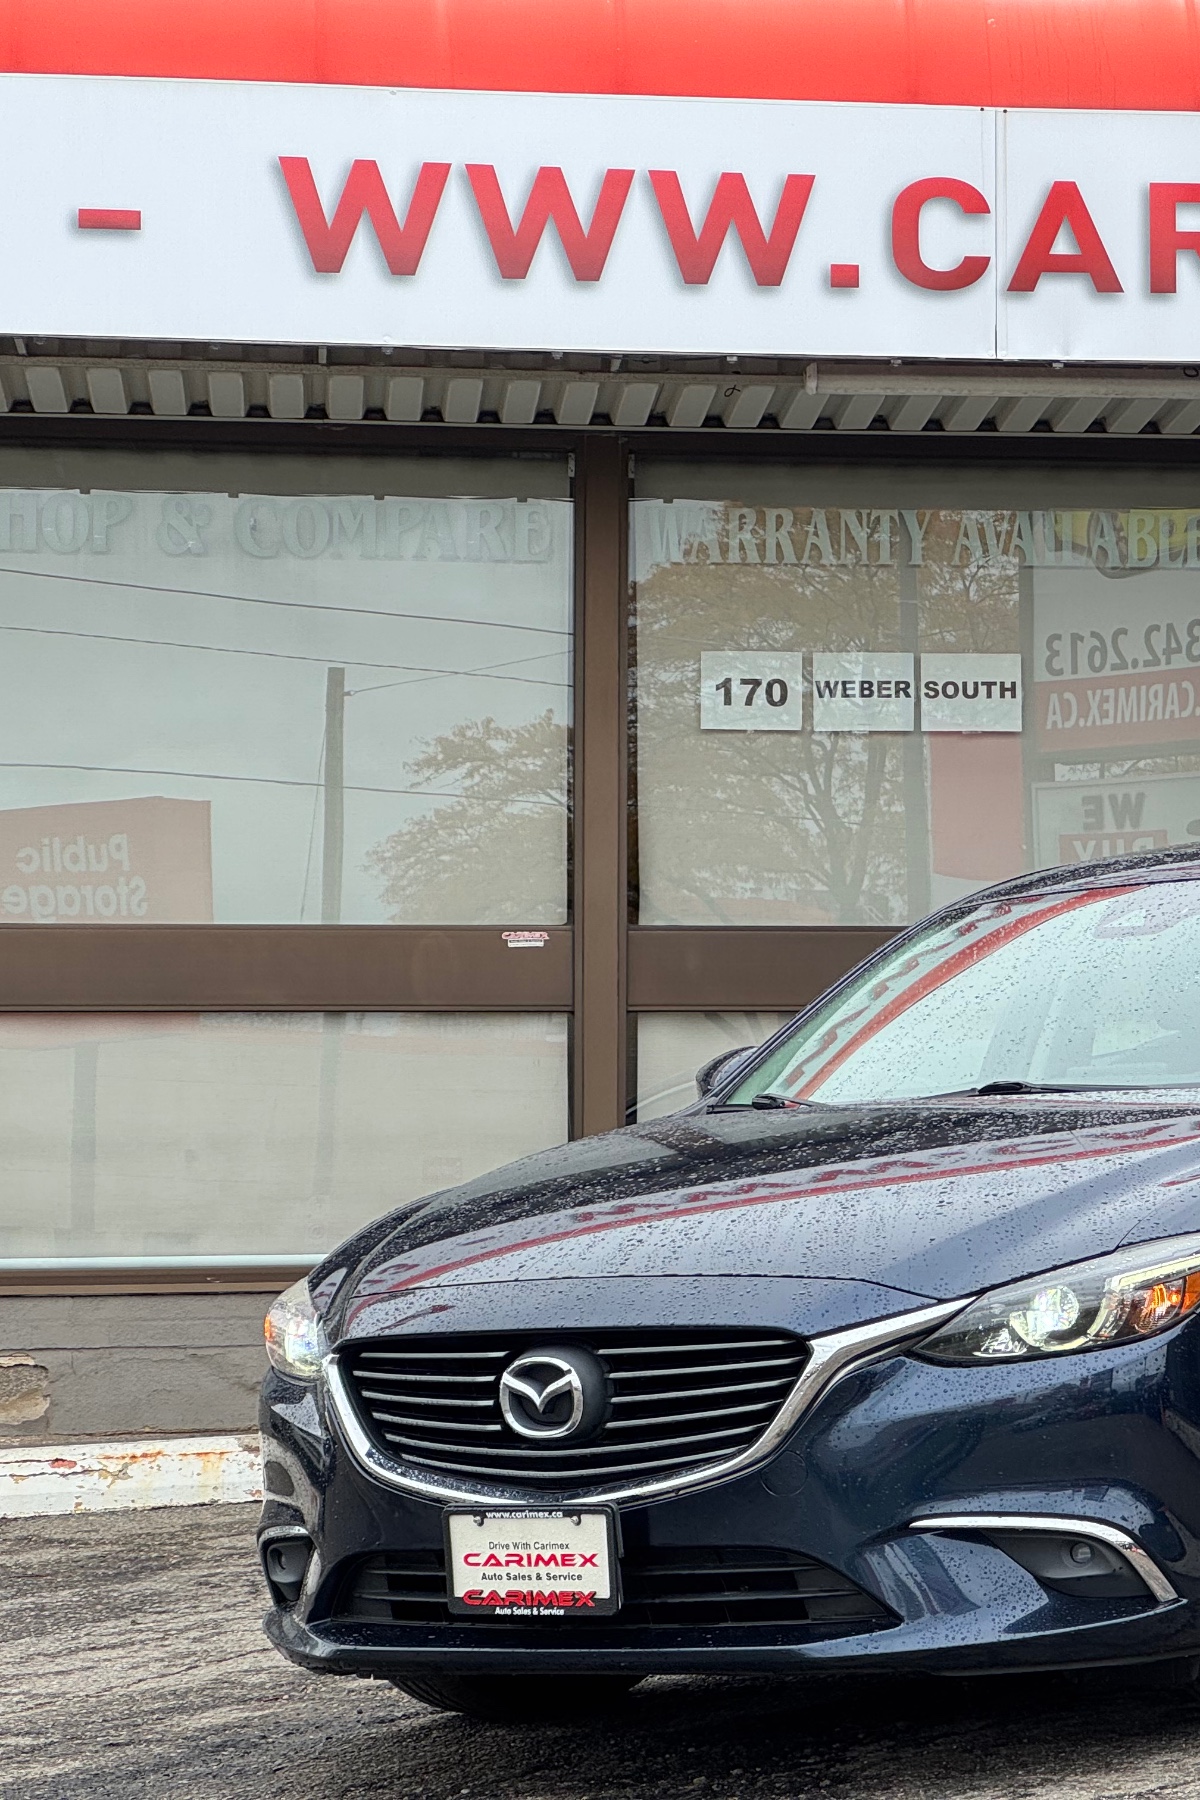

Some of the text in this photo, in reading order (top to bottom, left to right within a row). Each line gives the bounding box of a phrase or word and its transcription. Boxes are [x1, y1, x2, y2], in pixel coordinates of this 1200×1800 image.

[156, 494, 213, 556] &
[233, 498, 553, 564] COMPARE
[649, 506, 934, 567] WARRANTY
[714, 677, 1018, 708] 170 WEBER SOUTH
[485, 1510, 564, 1519] www.carimex.ca
[488, 1541, 570, 1550] Drive With Carimex
[463, 1552, 599, 1568] CARIMEX
[481, 1572, 583, 1581] Auto Sales & Service
[462, 1589, 597, 1608] CARIMEX
[494, 1607, 565, 1616] Auto Sales & Service
